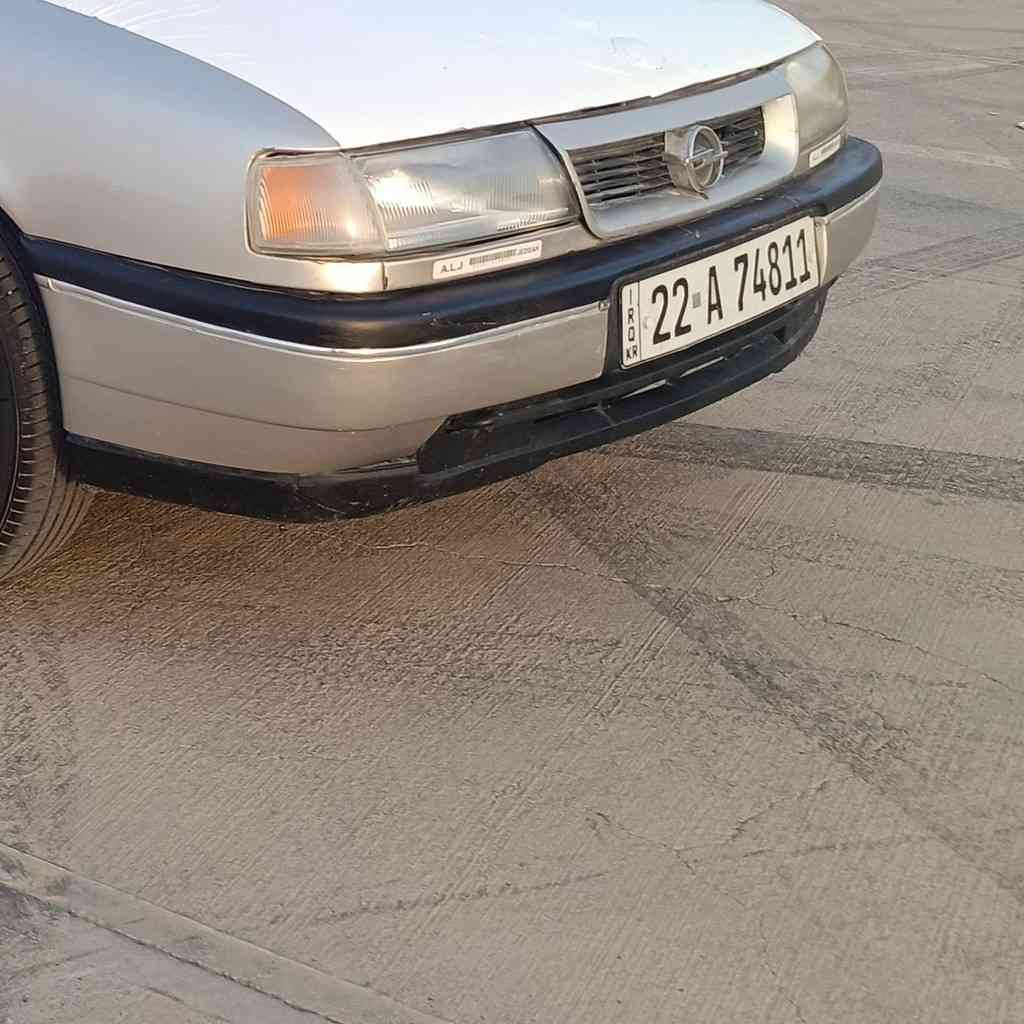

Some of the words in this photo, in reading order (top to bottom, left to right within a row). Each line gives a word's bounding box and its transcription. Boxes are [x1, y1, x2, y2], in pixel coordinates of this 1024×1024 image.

[651, 277, 692, 345] 22
[707, 265, 724, 325] A
[734, 228, 811, 312] 74811
[626, 345, 638, 360] KR
